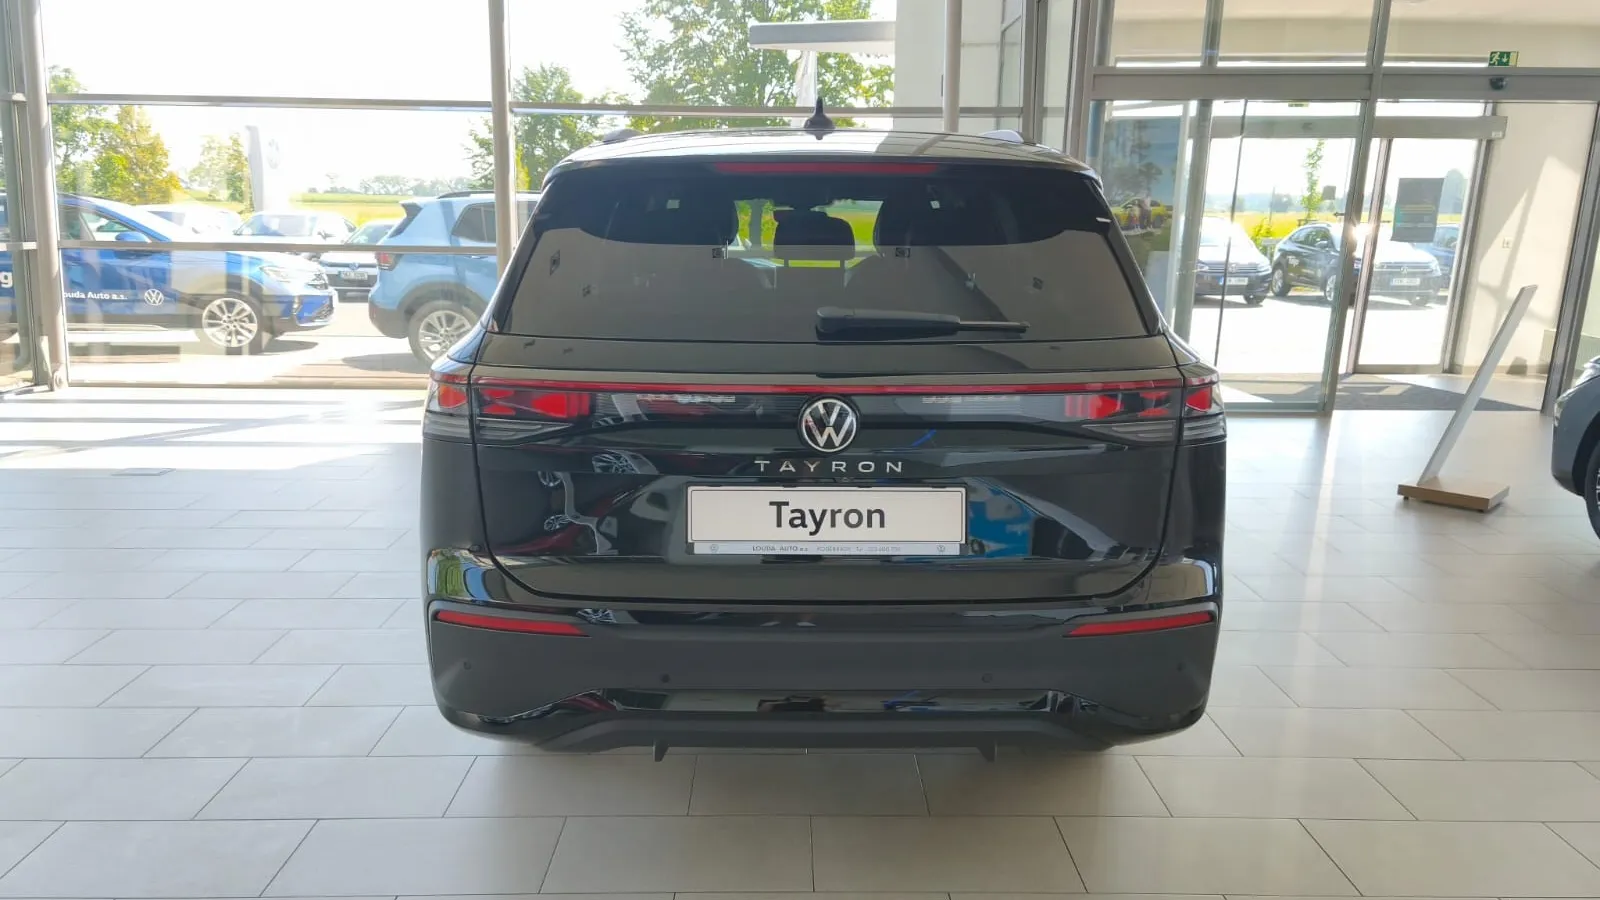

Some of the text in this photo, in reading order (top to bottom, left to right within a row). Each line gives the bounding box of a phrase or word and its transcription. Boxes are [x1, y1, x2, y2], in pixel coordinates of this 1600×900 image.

[64, 291, 86, 299] ouda
[87, 291, 110, 299] Auto
[754, 460, 903, 473] TAYRON
[769, 501, 885, 536] Tayron
